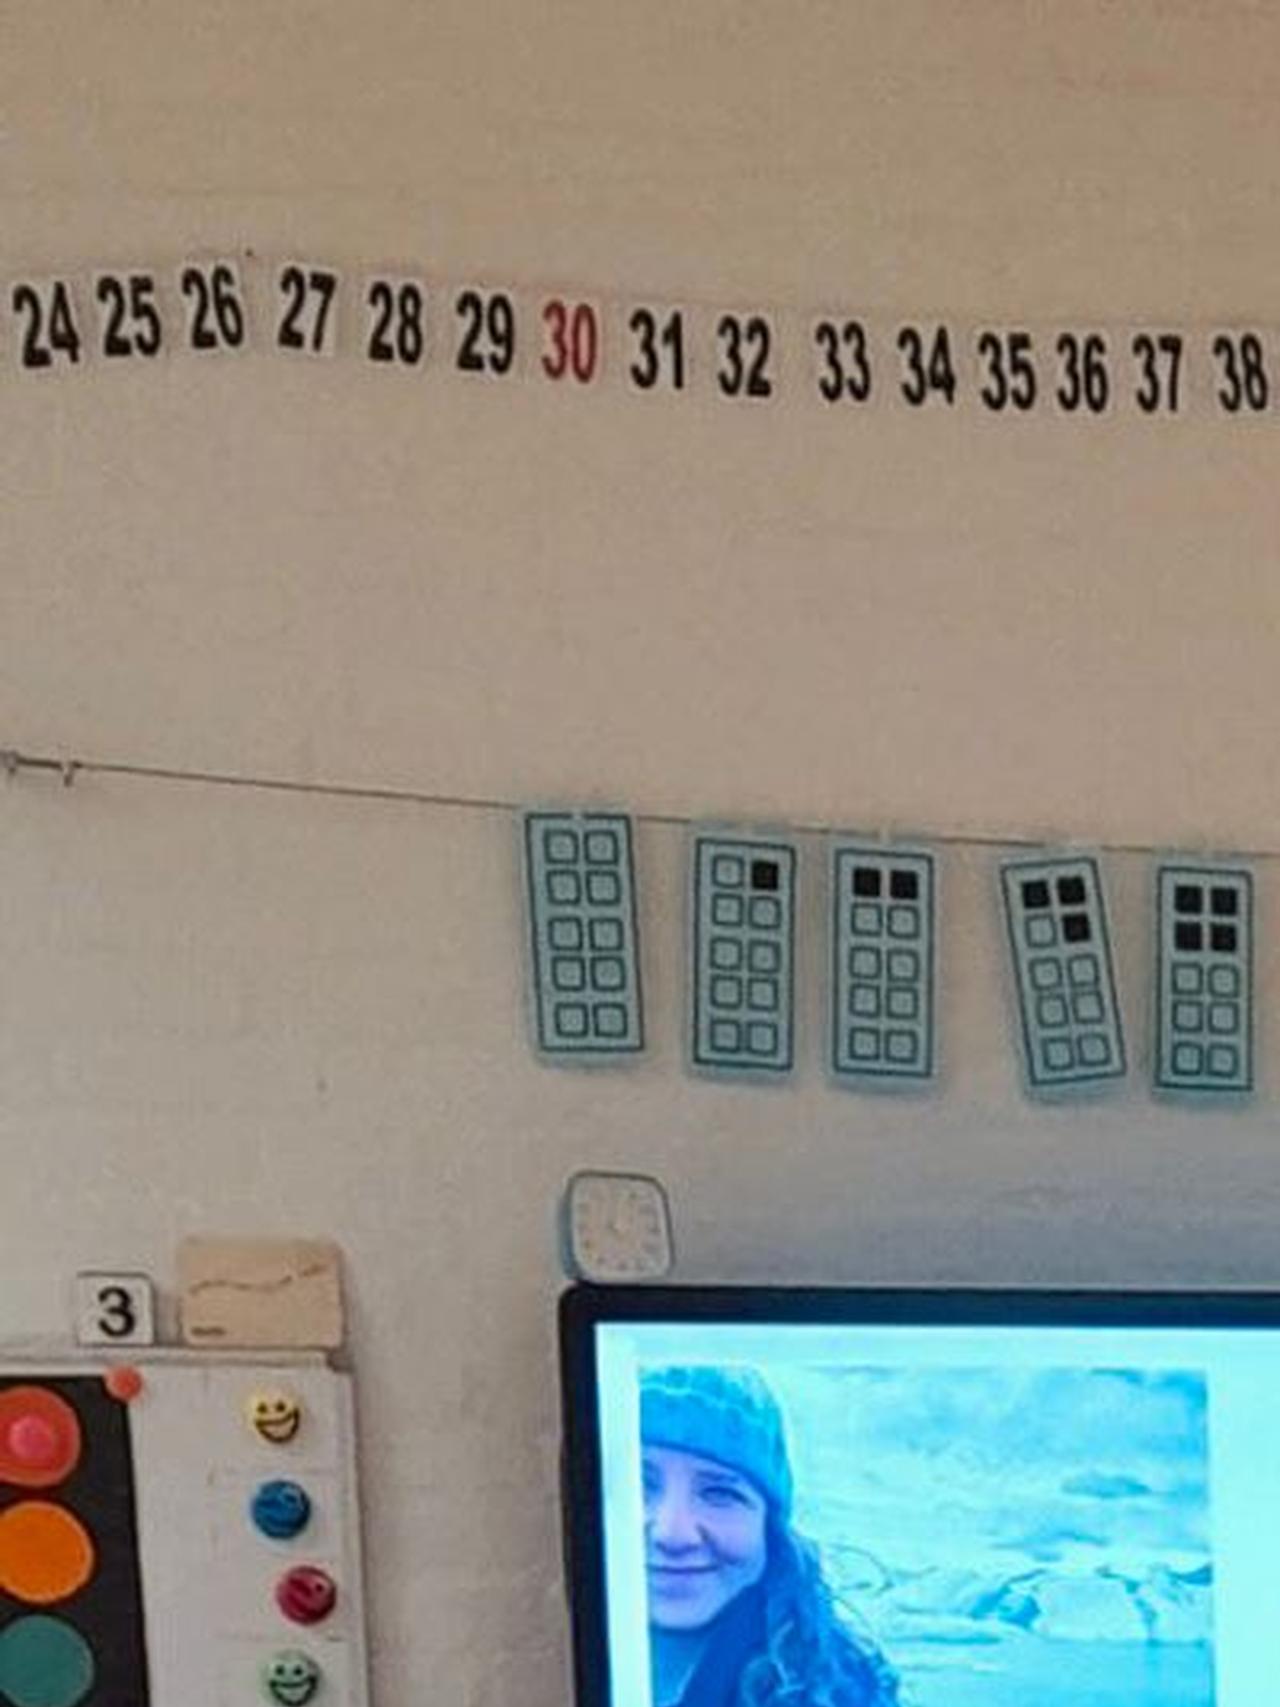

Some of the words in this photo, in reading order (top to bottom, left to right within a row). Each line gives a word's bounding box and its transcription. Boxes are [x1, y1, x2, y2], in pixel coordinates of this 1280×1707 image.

[12, 280, 82, 370] 24
[95, 275, 164, 359] 25
[180, 264, 245, 351] 26
[276, 265, 338, 353] 27
[367, 280, 425, 367] 28
[455, 290, 516, 376] 29
[540, 299, 599, 385] 30
[628, 307, 686, 392] 31
[716, 314, 773, 399] 32
[814, 320, 873, 404] 33
[896, 324, 958, 408] 34
[976, 331, 1039, 413] 35
[1055, 332, 1110, 415] 36
[1131, 333, 1184, 415] 37
[1212, 332, 1270, 414] 38
[98, 1286, 136, 1337] 3
